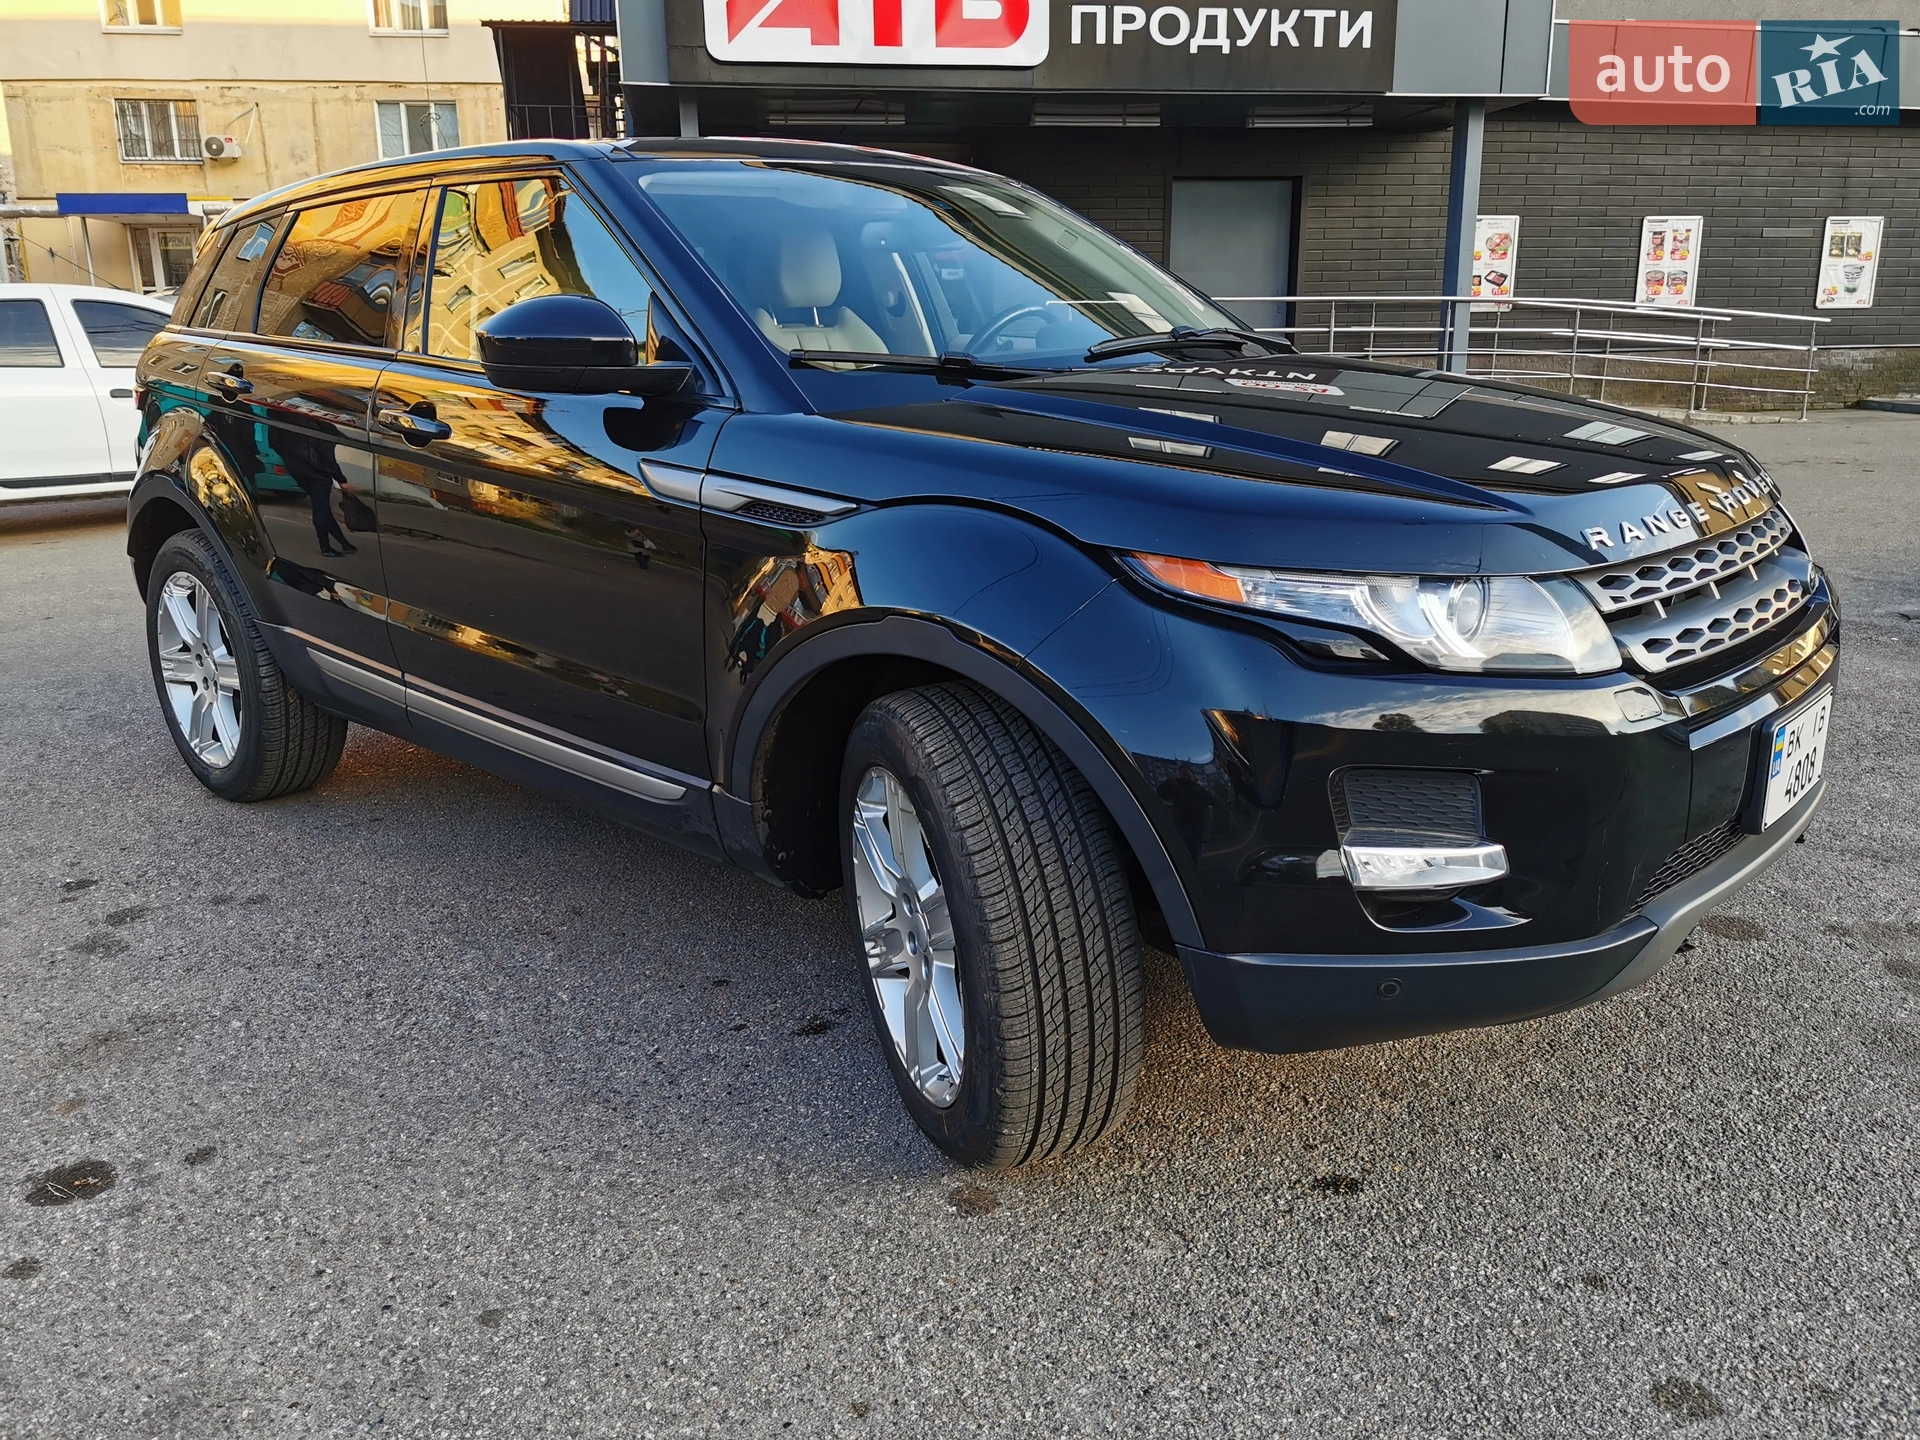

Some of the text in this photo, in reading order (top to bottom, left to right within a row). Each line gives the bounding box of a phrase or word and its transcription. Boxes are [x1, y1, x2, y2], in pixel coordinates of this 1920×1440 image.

[1071, 5, 1373, 54] ПРОДУКТИ
[1580, 501, 1711, 550] RANGE
[1786, 705, 1825, 758] BK IB
[1784, 746, 1817, 803] 4808
